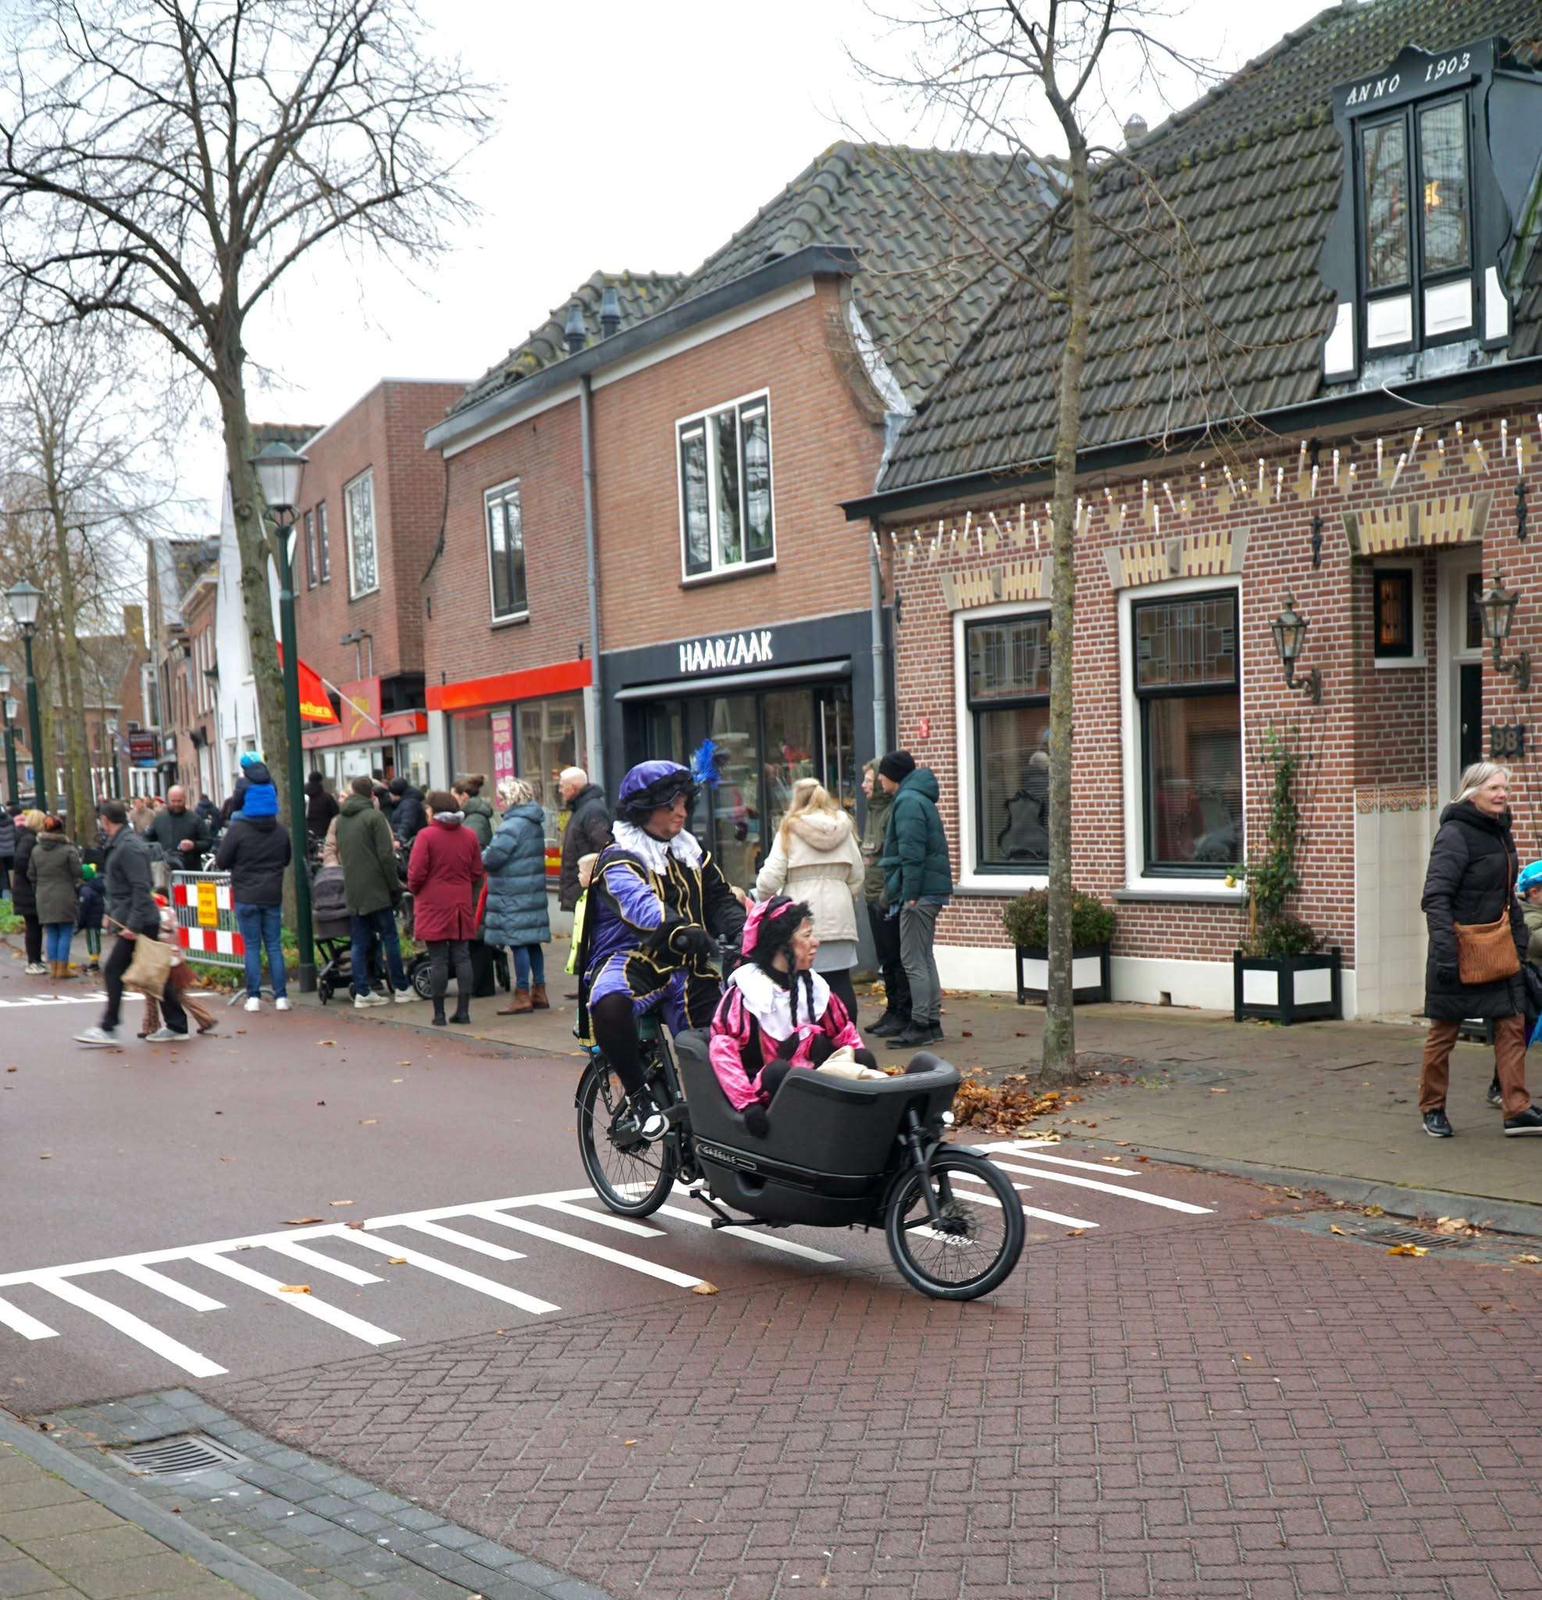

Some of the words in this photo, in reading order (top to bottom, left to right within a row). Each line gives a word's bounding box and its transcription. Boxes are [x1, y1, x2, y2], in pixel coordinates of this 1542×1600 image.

[1345, 73, 1400, 106] ANNO
[1424, 52, 1471, 82] 1903
[679, 630, 774, 673] HAARZAAK
[1493, 730, 1518, 751] 98
